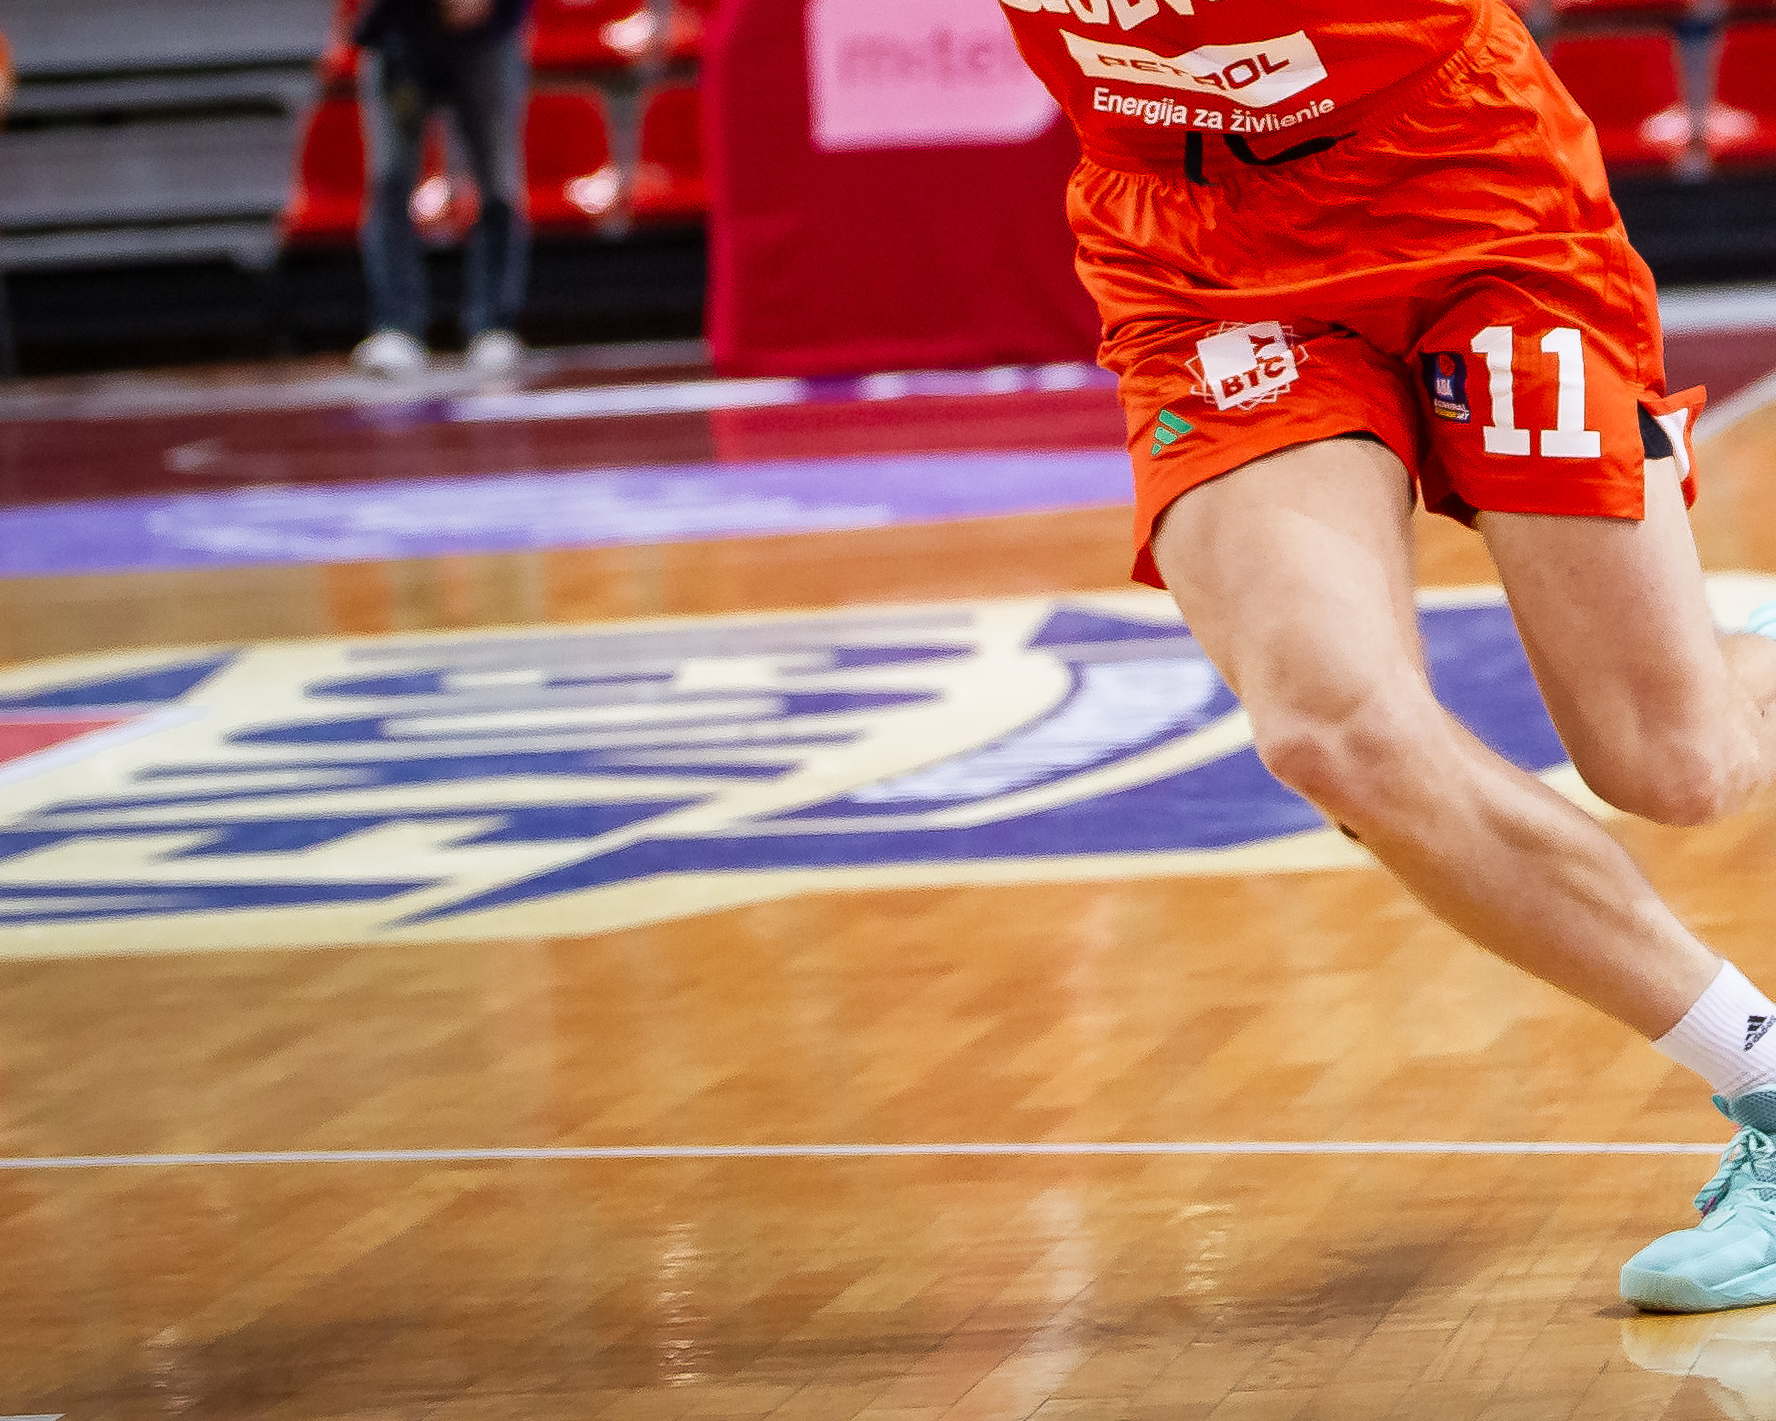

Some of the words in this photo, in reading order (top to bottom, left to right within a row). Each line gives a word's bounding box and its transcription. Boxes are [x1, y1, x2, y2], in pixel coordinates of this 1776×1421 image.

[1093, 86, 1188, 128] Energija
[1193, 107, 1224, 130] za
[1220, 357, 1286, 399] BTC
[1470, 325, 1601, 458] 11
